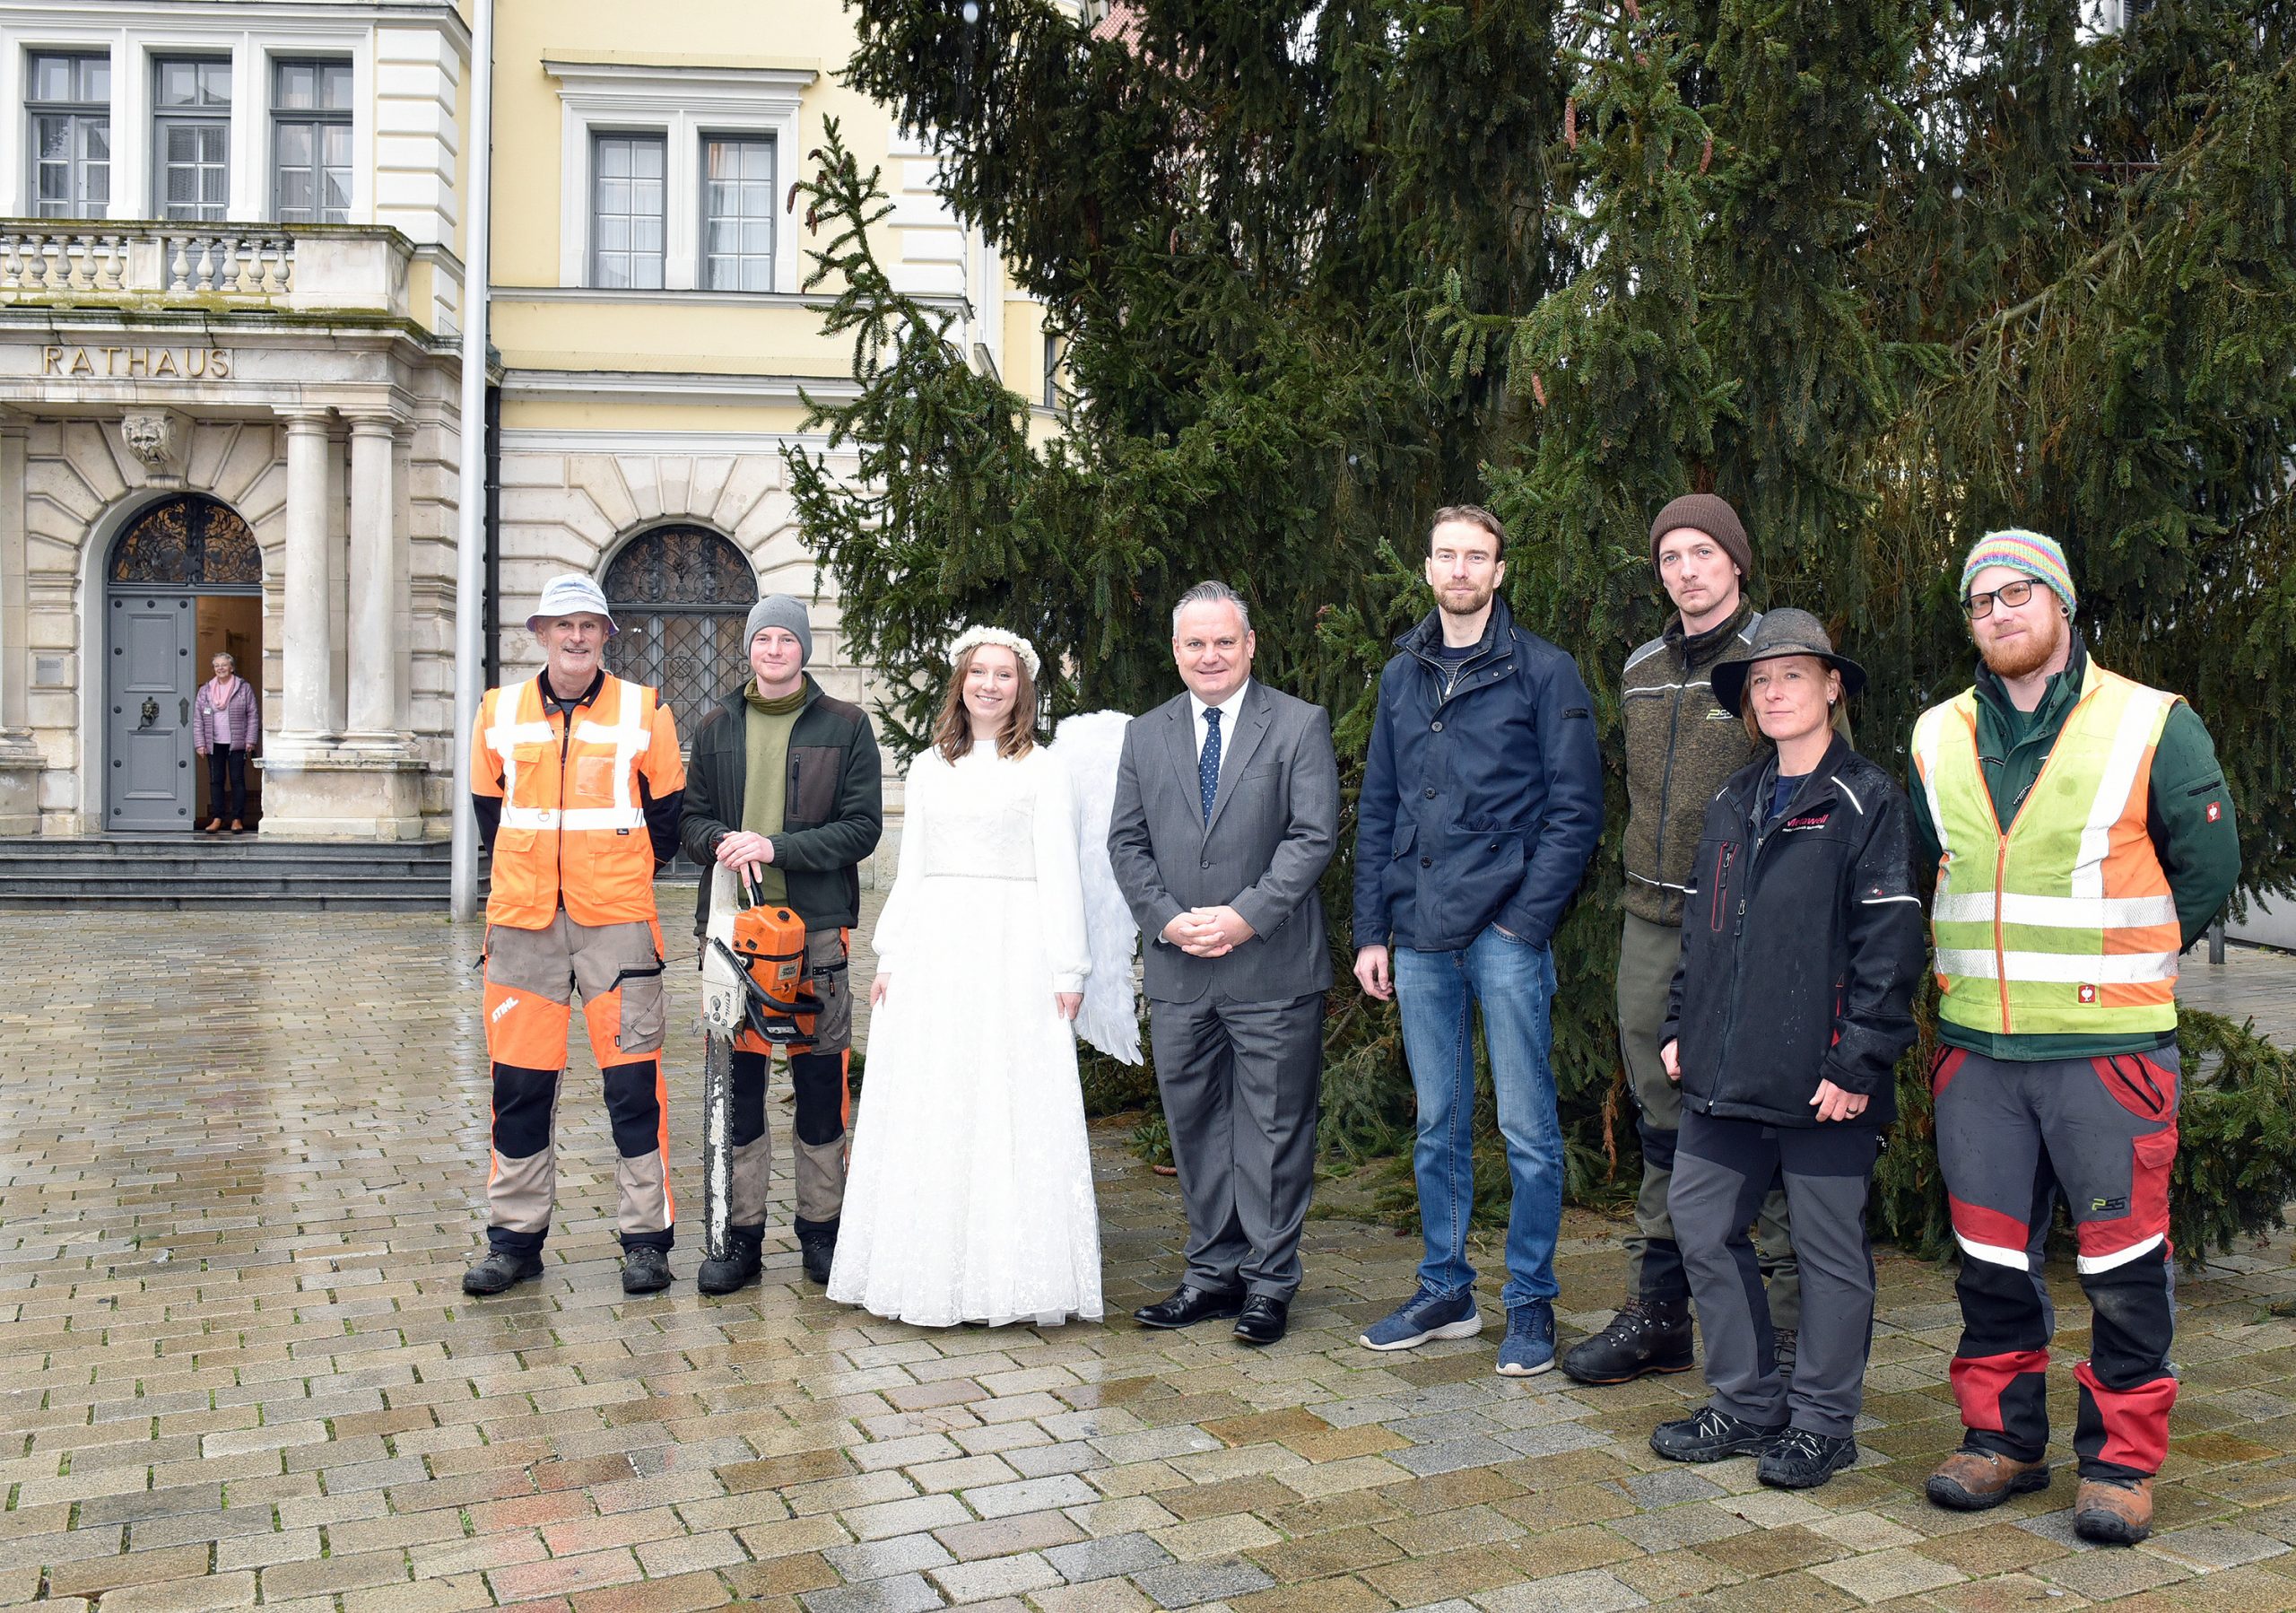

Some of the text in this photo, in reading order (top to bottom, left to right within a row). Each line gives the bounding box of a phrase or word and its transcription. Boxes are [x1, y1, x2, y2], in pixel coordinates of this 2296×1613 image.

[44, 345, 230, 377] RATHAUS
[491, 996, 519, 1024] STIHL
[2091, 1196, 2127, 1211] PSS
